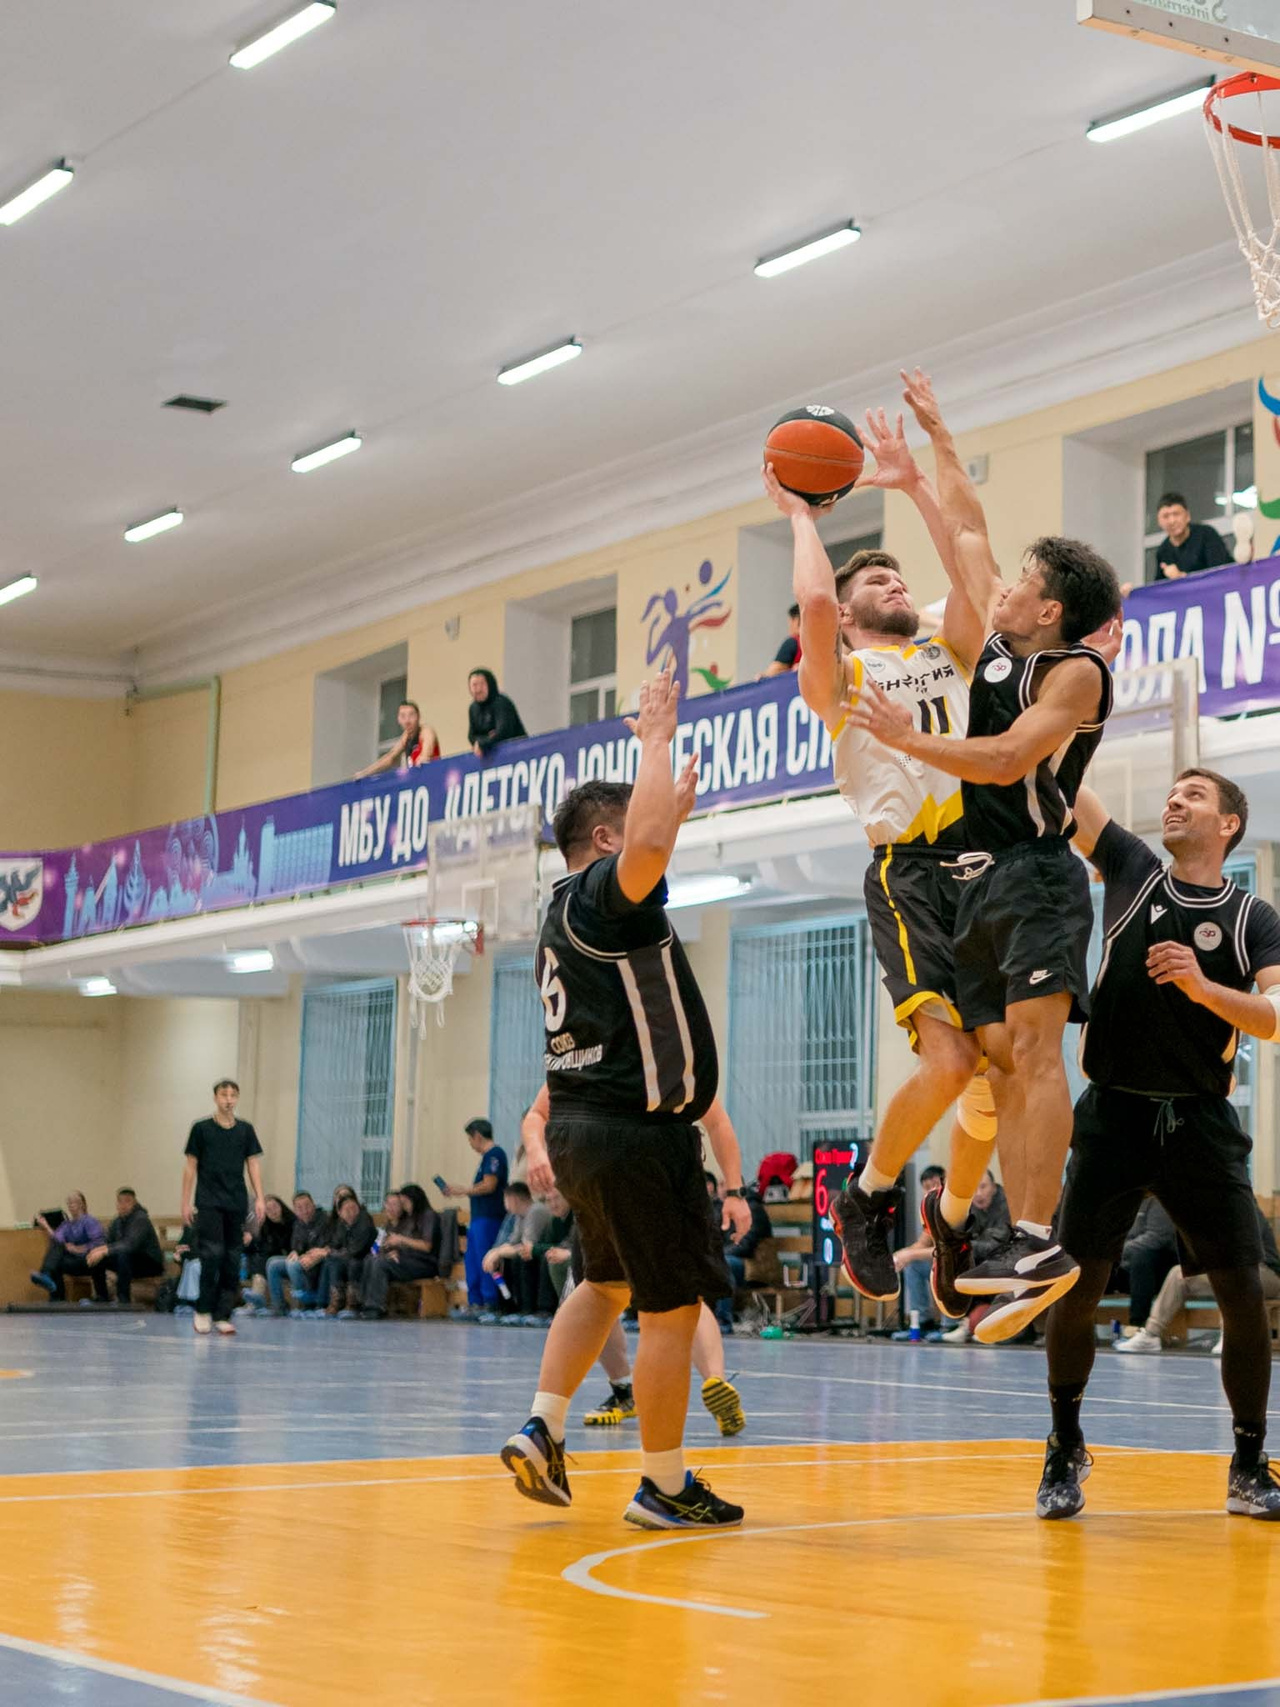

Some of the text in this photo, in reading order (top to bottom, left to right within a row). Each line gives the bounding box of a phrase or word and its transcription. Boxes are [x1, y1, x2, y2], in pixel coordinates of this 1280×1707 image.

[917, 695, 951, 734] 11
[338, 794, 391, 867] МБУ
[392, 786, 429, 864] ДО
[815, 1168, 829, 1216] 6
